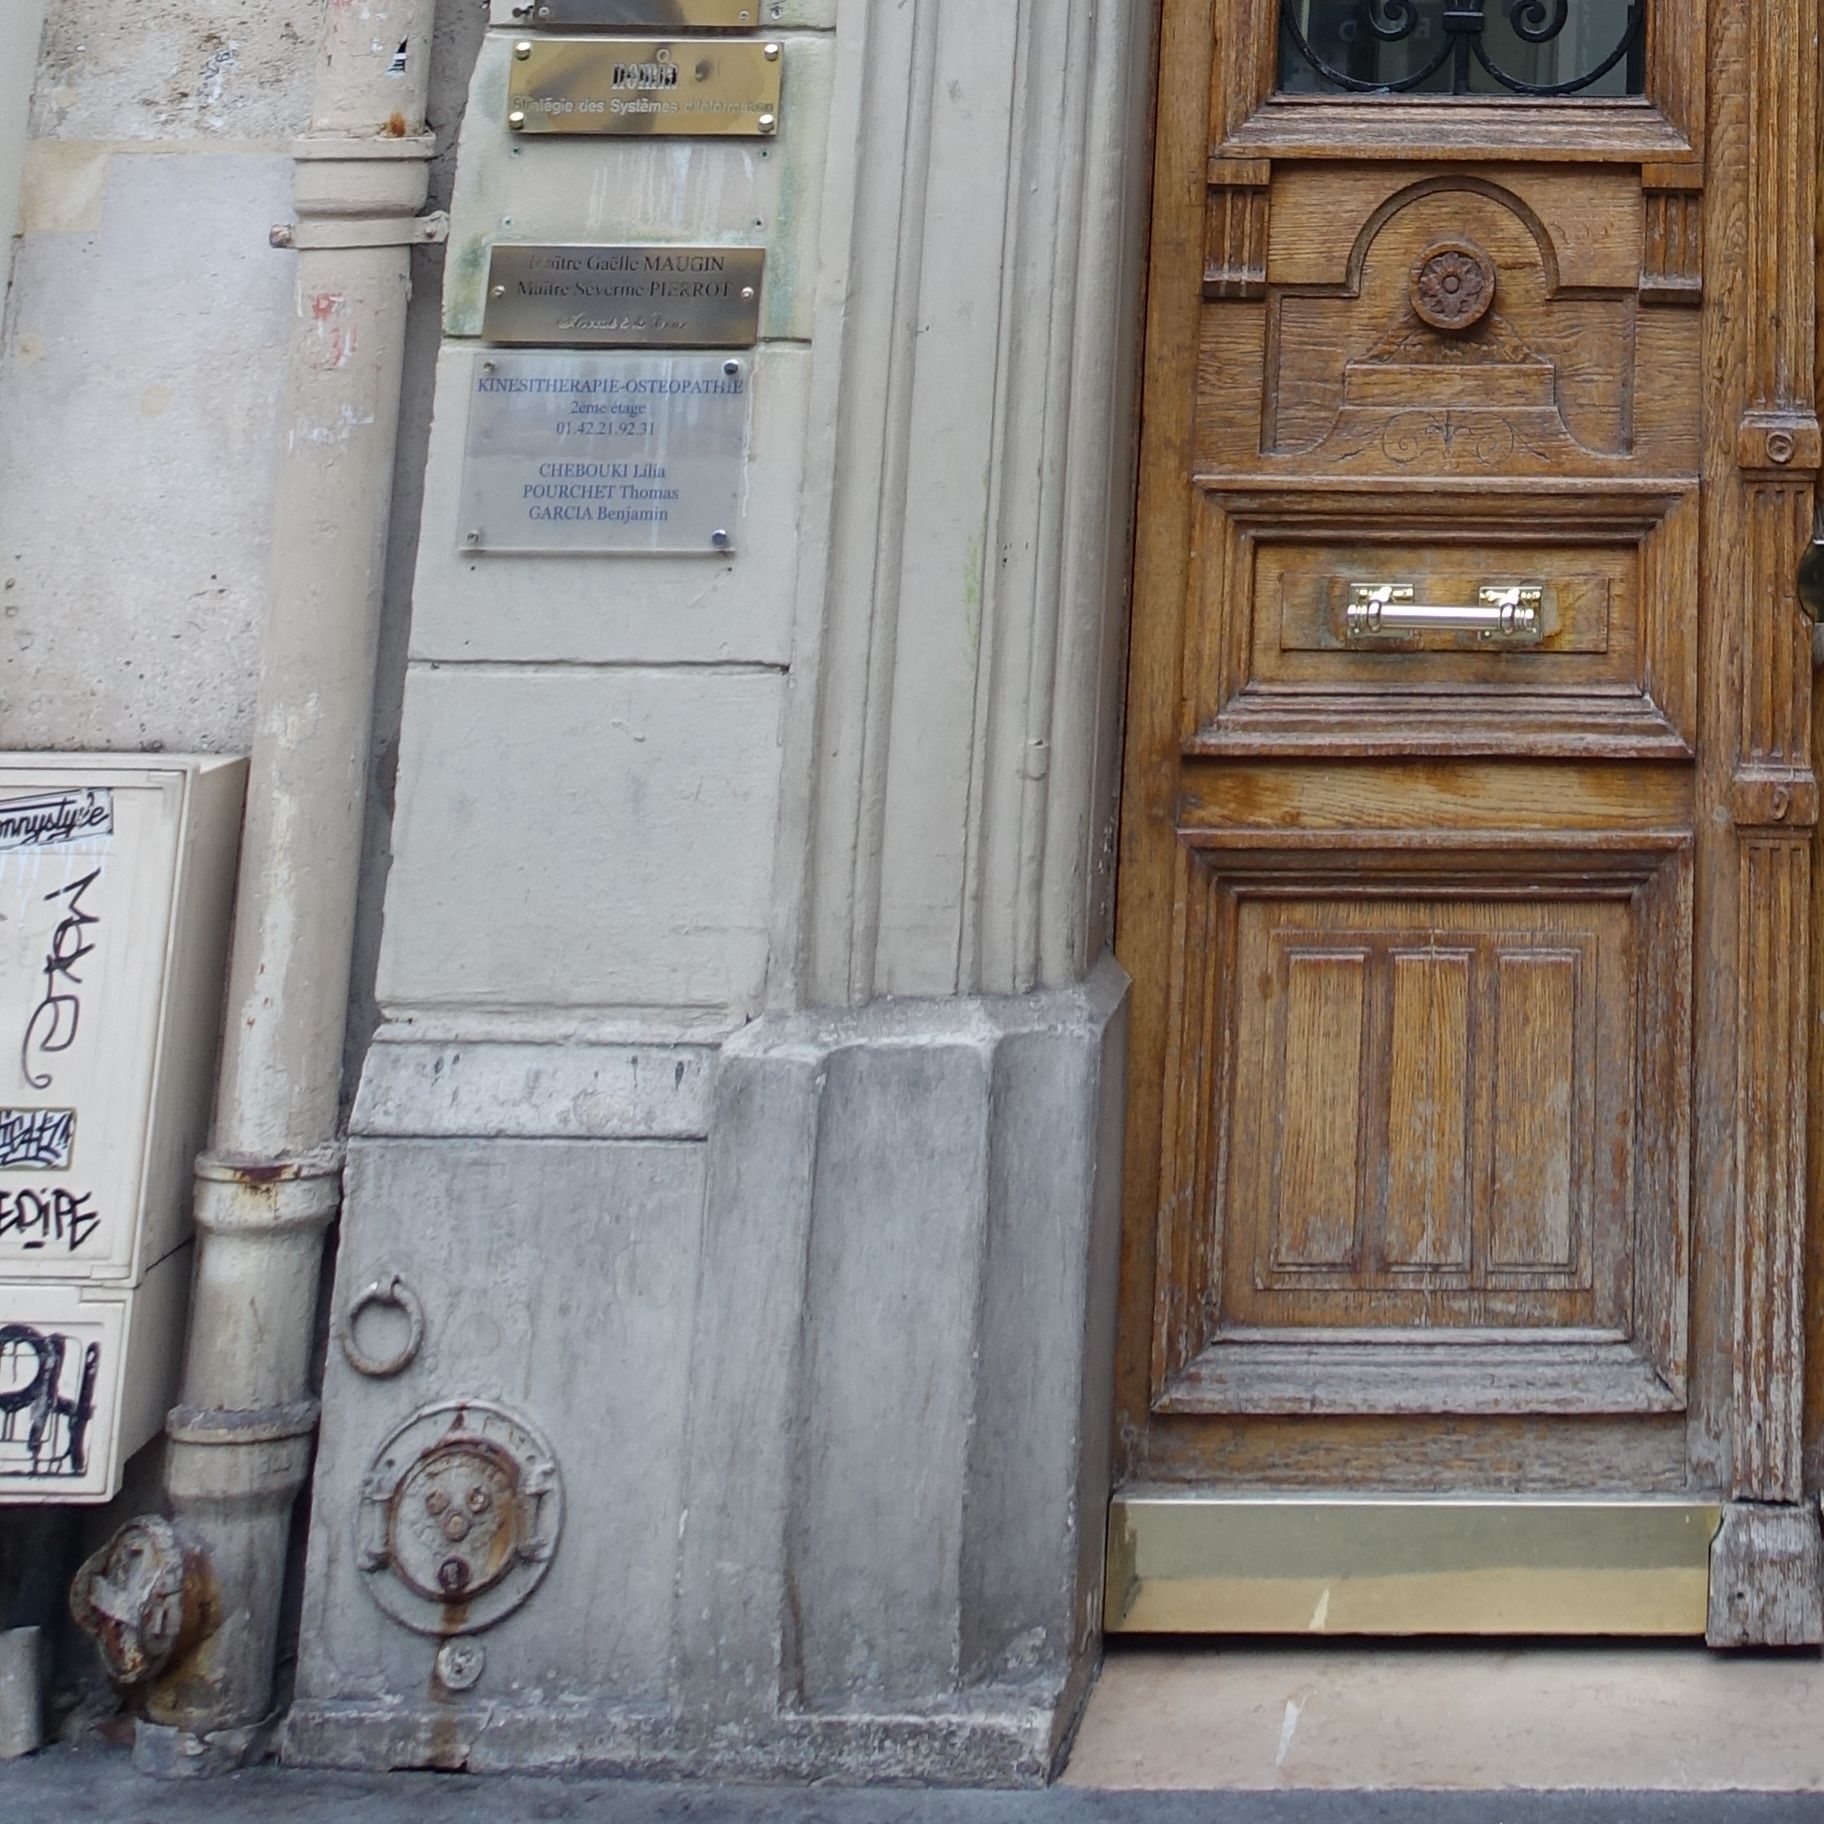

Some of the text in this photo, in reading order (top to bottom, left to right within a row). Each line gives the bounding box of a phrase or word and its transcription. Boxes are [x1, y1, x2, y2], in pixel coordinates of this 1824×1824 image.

[579, 99, 605, 113] des
[610, 98, 679, 116] Systèmes
[586, 255, 639, 272] Gaëlle
[643, 256, 726, 272] MAUGIN
[649, 281, 733, 298] PIERROT
[477, 378, 744, 395] KINESITHERAPIE-OSTEOPATHIE
[610, 400, 647, 418] étage
[556, 421, 656, 436] 01.42.21.92.31
[539, 463, 666, 479] CHEBOUKI Lilia
[522, 484, 680, 500] POURCHET Thomas
[528, 506, 669, 525] GARCIA Benjamin
